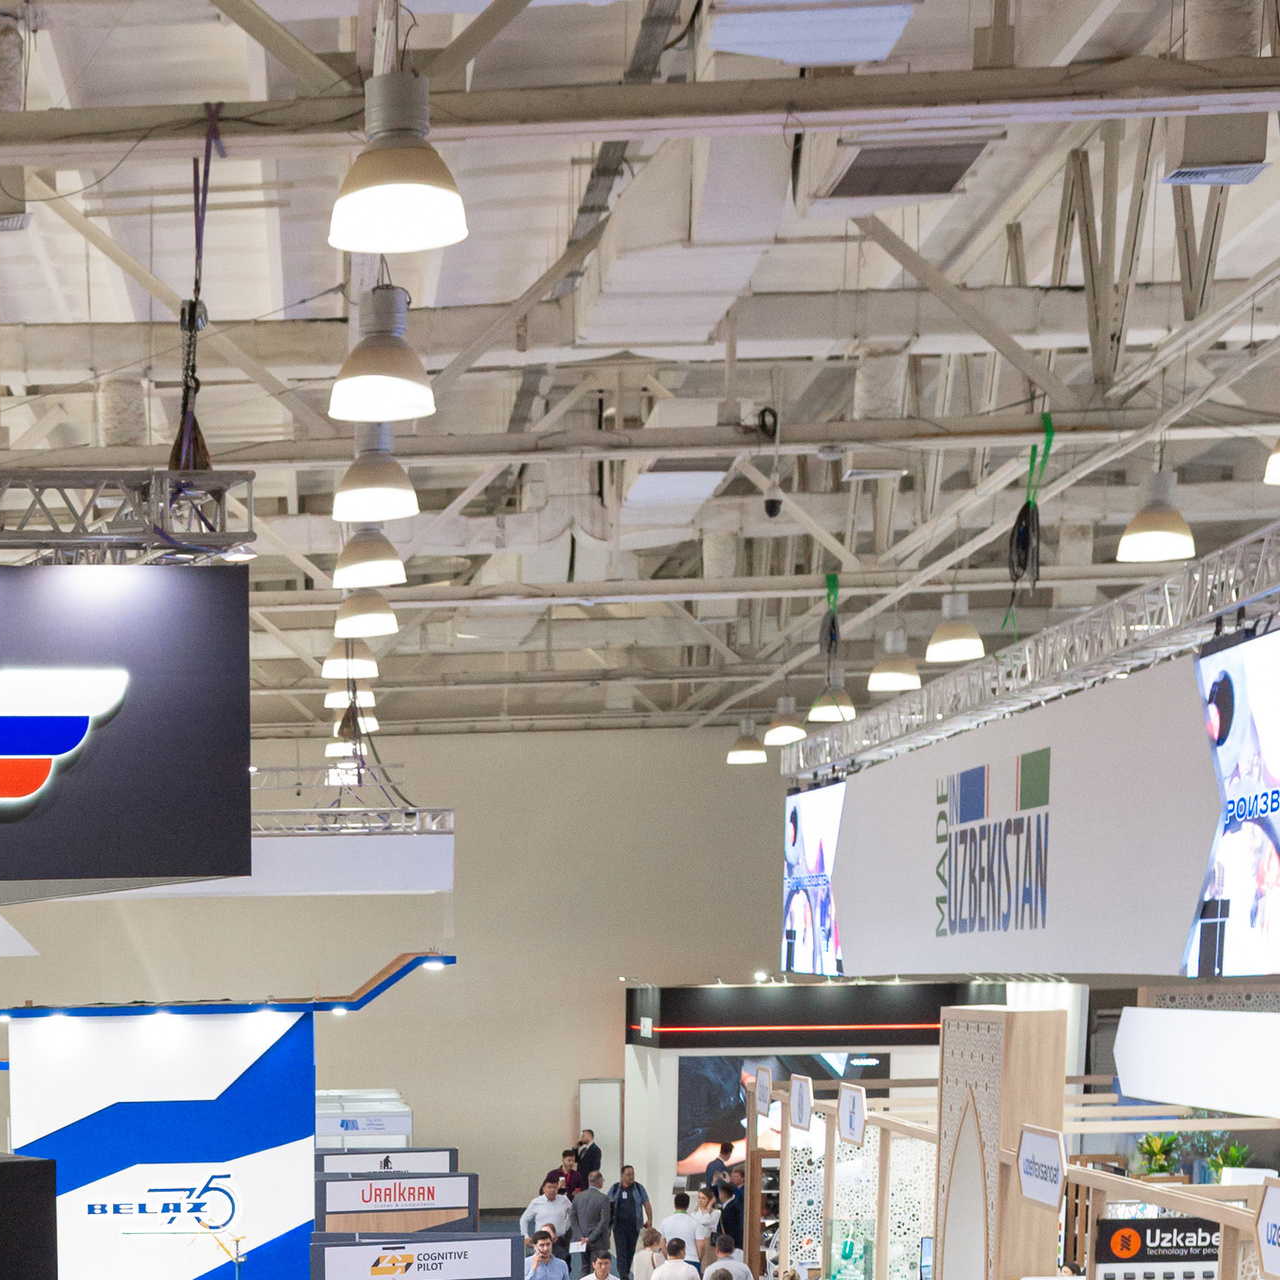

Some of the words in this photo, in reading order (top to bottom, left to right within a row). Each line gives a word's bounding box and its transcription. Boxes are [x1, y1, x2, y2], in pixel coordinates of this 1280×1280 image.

[935, 778, 949, 937] MADE
[948, 812, 1049, 936] UZBEKISTAN
[87, 1202, 208, 1215] BELAZ
[417, 1251, 469, 1261] COGNITIVE
[1147, 1247, 1188, 1256] Technology
[417, 1262, 444, 1271] PILOT
